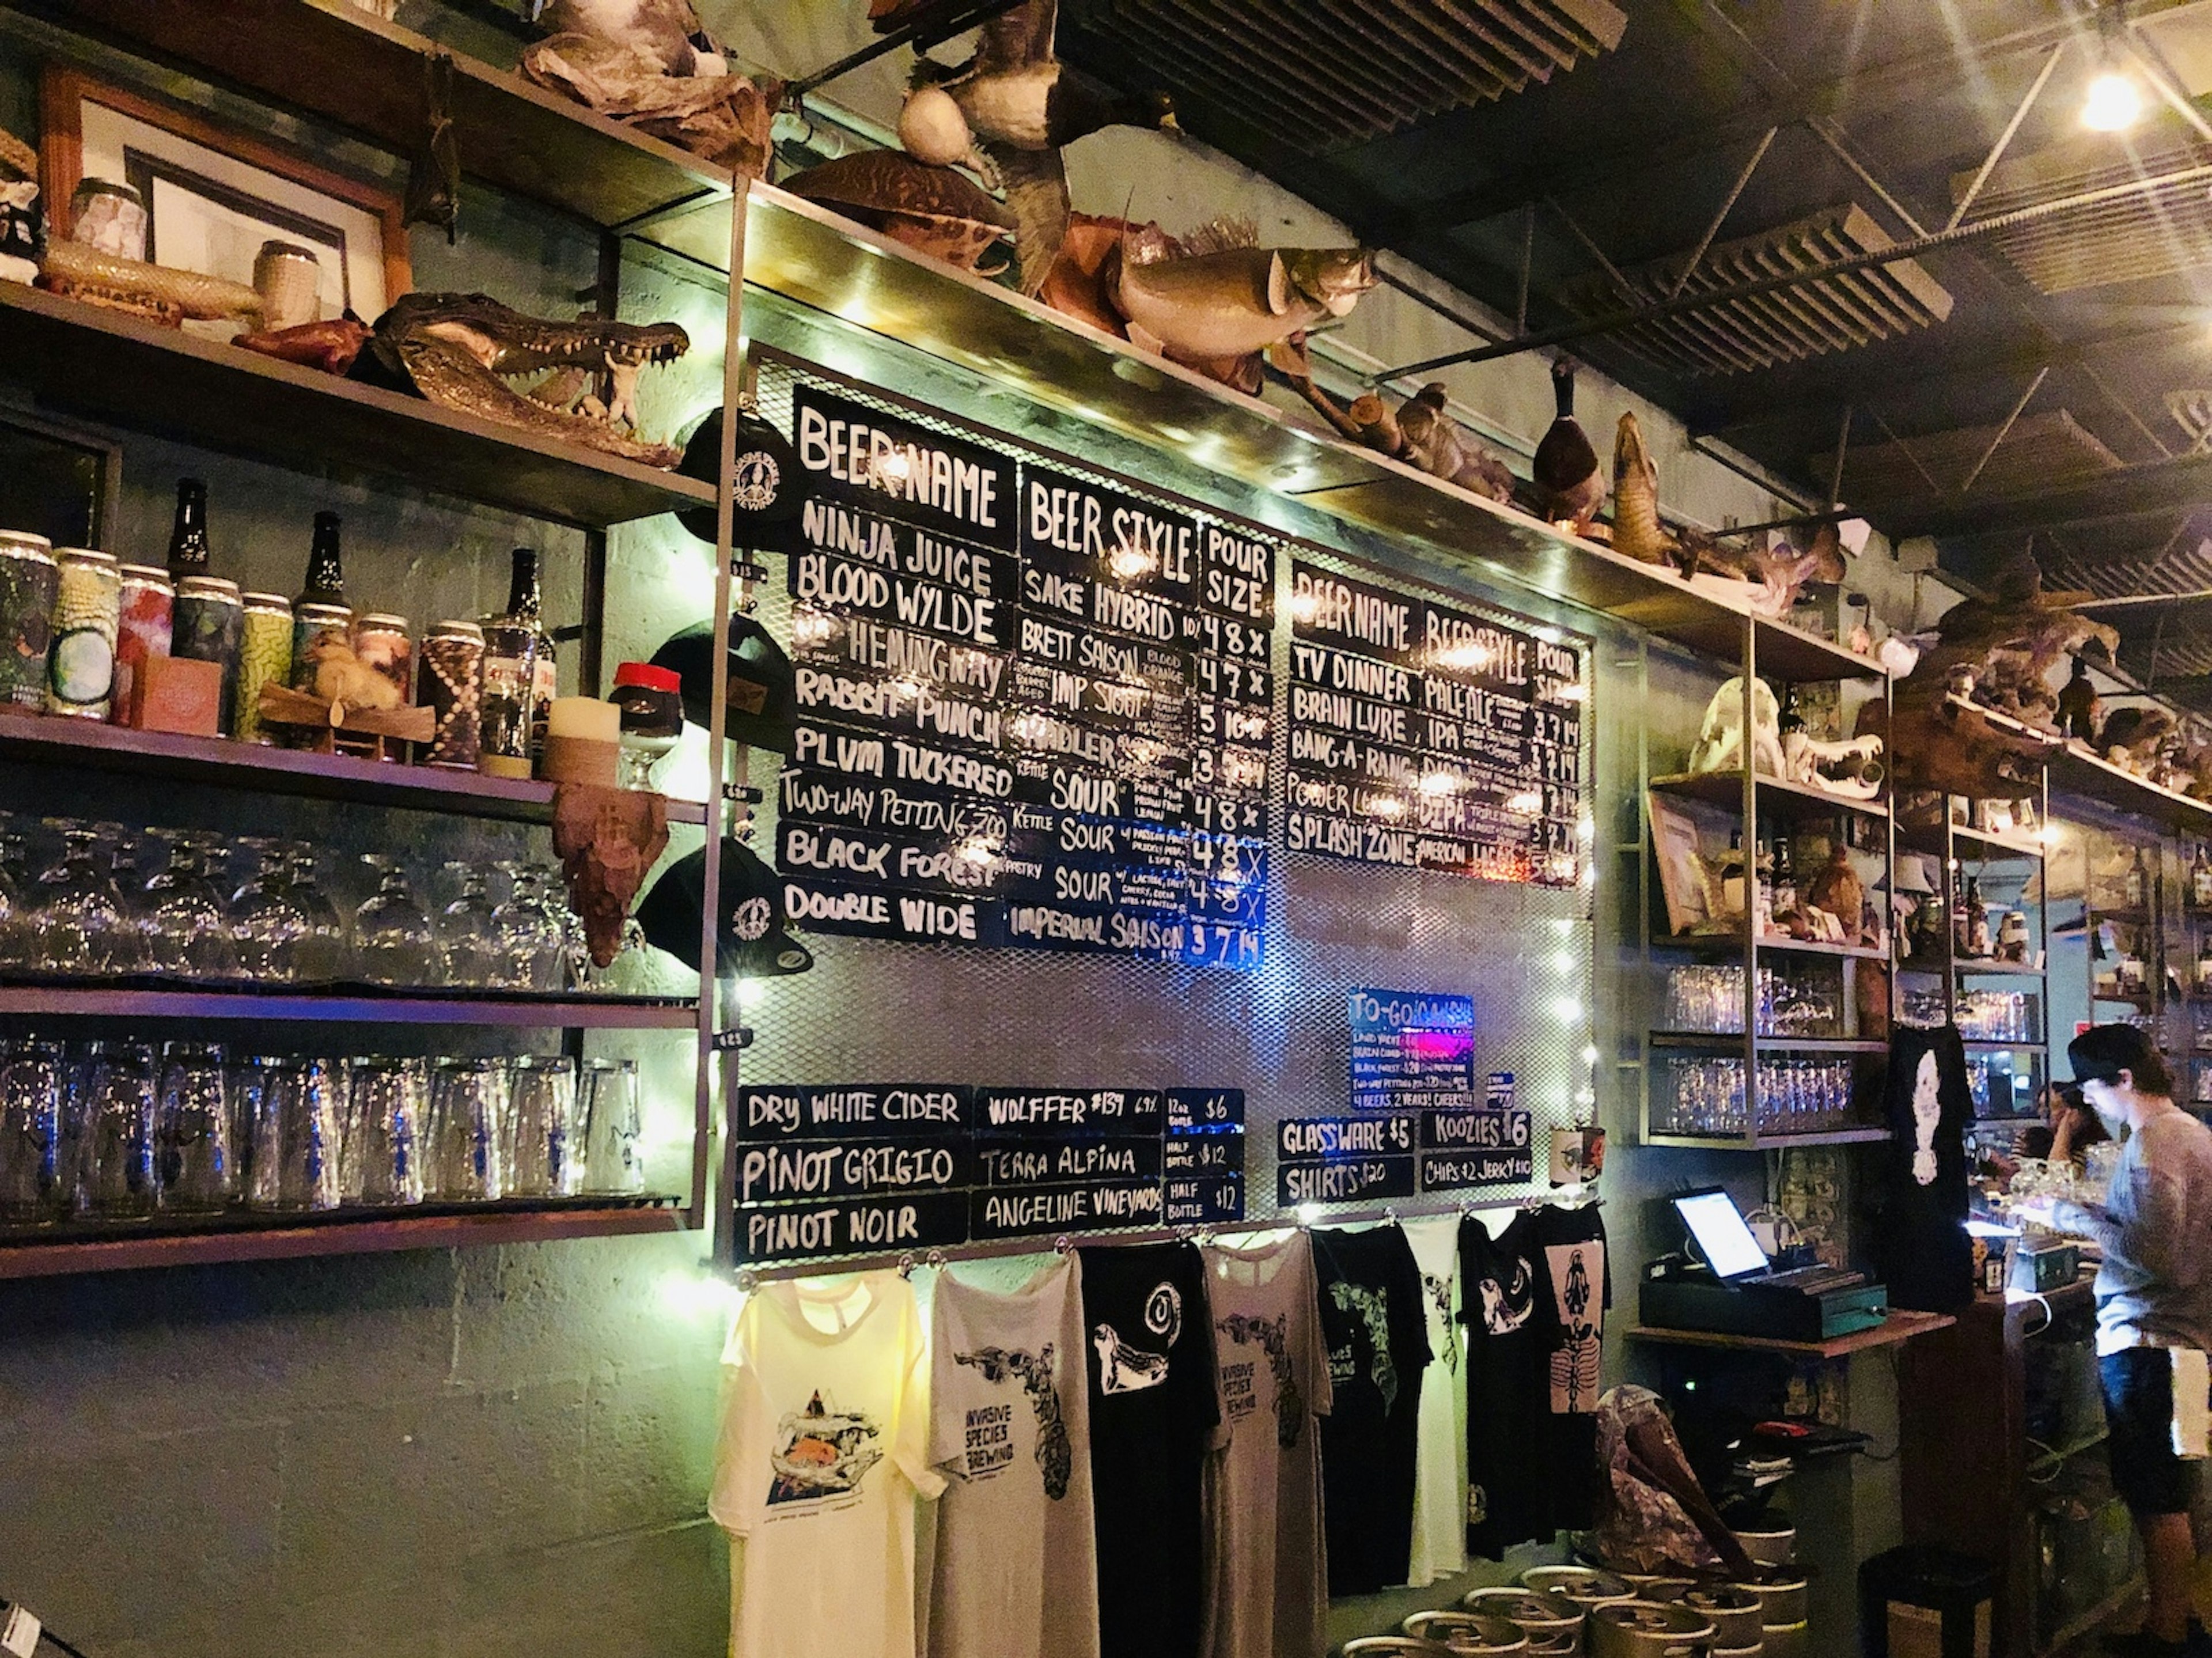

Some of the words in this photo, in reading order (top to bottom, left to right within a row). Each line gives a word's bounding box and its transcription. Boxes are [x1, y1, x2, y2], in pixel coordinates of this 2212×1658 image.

[800, 406, 899, 498] BEER
[905, 442, 997, 528] NAME
[802, 499, 899, 571] NINJA
[906, 531, 992, 597] JUICE
[1031, 481, 1105, 558] BEER
[1111, 507, 1191, 584] STYLE
[1209, 529, 1268, 584] POUR
[797, 554, 890, 608] BLOOD
[895, 580, 998, 644] WYLDE
[1025, 569, 1084, 616] SAKE
[1094, 581, 1175, 641] HYBRID
[1207, 569, 1263, 618] SIZE
[1295, 571, 1353, 639] BEER
[1355, 591, 1411, 653] NAME
[1021, 618, 1075, 661] BRETT
[1078, 634, 1140, 676] SAISON
[1205, 615, 1219, 650] 4
[1225, 622, 1245, 654] 8
[848, 619, 1004, 698] HEMINGWAY
[1200, 658, 1218, 692] 4
[1222, 661, 1241, 699] 7
[1537, 641, 1574, 680] POUR
[795, 668, 899, 718] RABBIT
[916, 686, 1001, 747] PUNCH
[1294, 646, 1325, 680] TV
[1332, 654, 1411, 703] DINNER
[1425, 679, 1466, 718] PALE
[1465, 691, 1495, 727] ALE
[1199, 703, 1217, 733] 5
[1293, 687, 1353, 731] BRAIN
[1356, 701, 1407, 743] LURE
[1427, 718, 1460, 751] IPA
[795, 726, 884, 778] PLUM
[892, 741, 1013, 797] TUCKERED
[1291, 730, 1411, 780] BANG-A-RANG
[880, 788, 965, 838] PETTING
[969, 811, 1007, 839] ZOO
[1050, 768, 1120, 816] SOUR
[1195, 795, 1212, 830] 4
[1218, 800, 1237, 831] 8
[1419, 796, 1467, 832] DIPA
[1012, 807, 1054, 832] KETTLE
[1060, 817, 1116, 854] SOUR
[1287, 812, 1363, 860] SPLASH
[1366, 827, 1416, 865] ZONE
[787, 829, 892, 879] BLACK
[899, 847, 996, 887] FOREST
[1192, 839, 1215, 870] 4
[1055, 865, 1113, 905] SOUR
[784, 884, 891, 923] DOUBLE
[899, 897, 978, 940] WIDE
[1010, 906, 1107, 945] IMPERIAL
[1110, 911, 1185, 951] SAISON
[1191, 924, 1206, 956] 3
[1214, 926, 1231, 966] 7
[1351, 993, 1412, 1027] TO-GO
[811, 1092, 877, 1124] WHITE
[882, 1091, 960, 1122] CIDER
[988, 1095, 1086, 1126] WOLFFER
[1205, 1095, 1228, 1120] $6
[1166, 1141, 1190, 1153] HALF
[1198, 1142, 1226, 1167] $12
[1282, 1120, 1384, 1154] GLASSWARE
[1389, 1117, 1410, 1149] $5
[1435, 1115, 1500, 1148] KOOZIES
[1501, 1111, 1528, 1147] $6
[743, 1146, 843, 1201] PINOT
[844, 1146, 954, 1191] GRIGIO
[980, 1149, 1049, 1187] TERRA
[1058, 1144, 1136, 1176] ALPINA
[1166, 1154, 1195, 1168] BOTTLE
[1285, 1166, 1358, 1200] SHIRTS
[1359, 1163, 1387, 1189] $20
[1425, 1160, 1460, 1185] CHIPS
[1461, 1159, 1476, 1180] $2
[1478, 1157, 1516, 1181] JERKY
[1167, 1203, 1203, 1220] BOTTLE
[1169, 1182, 1199, 1200] HALF
[1215, 1184, 1236, 1210] $12
[749, 1208, 839, 1255] PINOT
[850, 1205, 919, 1244] NOIR
[984, 1190, 1088, 1228] ANGELINE
[1093, 1186, 1164, 1220] VINEYARDS
[966, 1405, 1012, 1428] INVASIVE
[966, 1424, 1007, 1448] SPECIES
